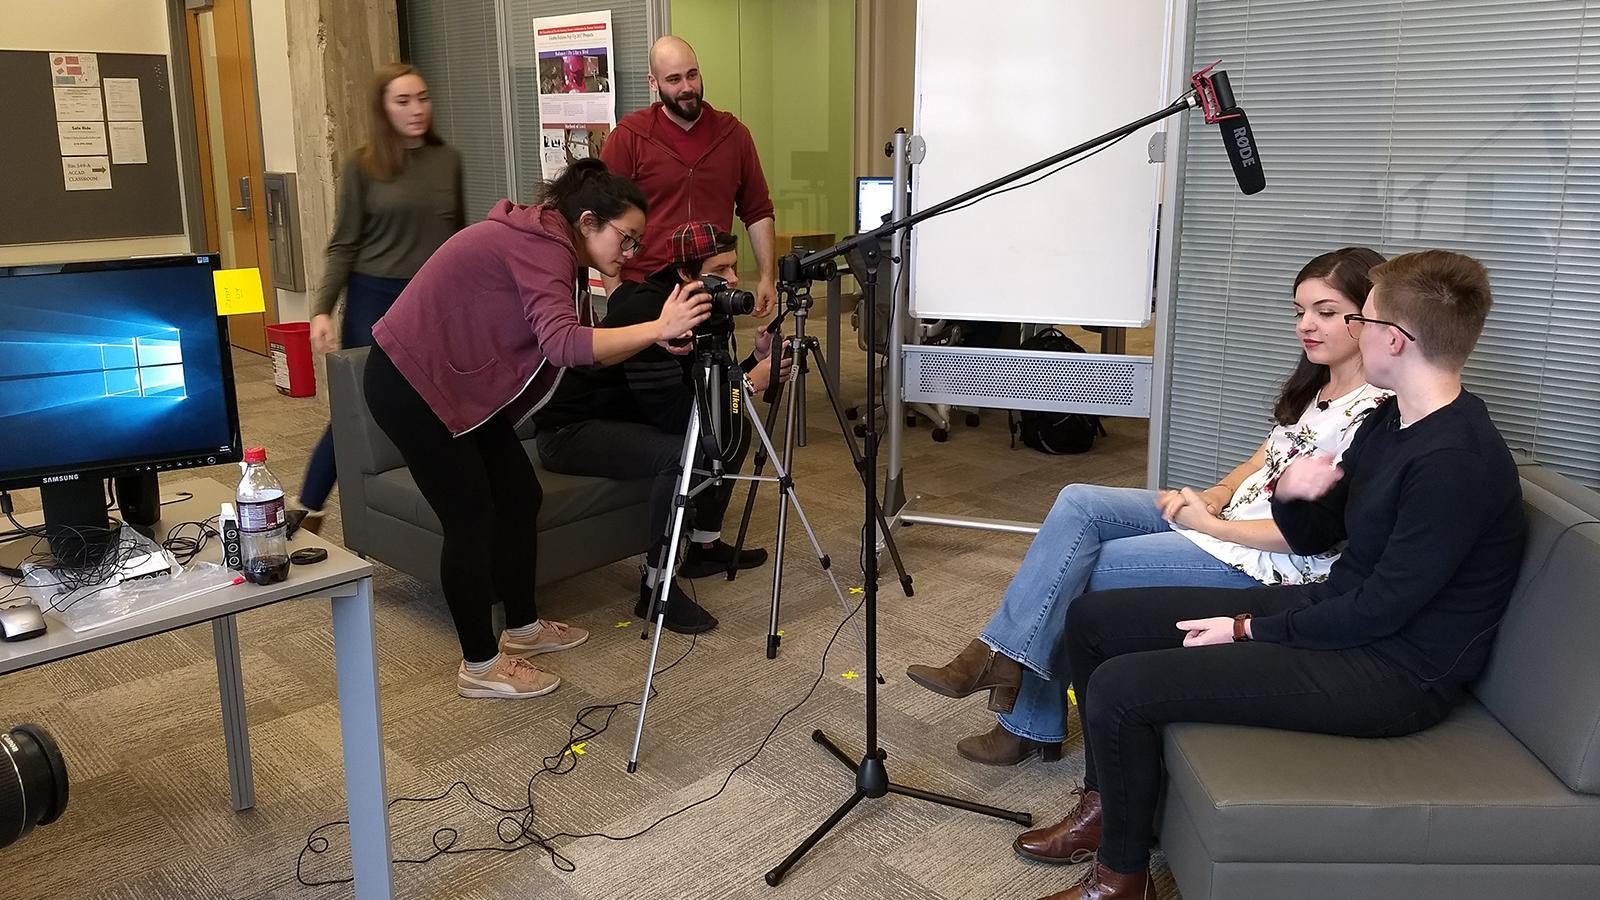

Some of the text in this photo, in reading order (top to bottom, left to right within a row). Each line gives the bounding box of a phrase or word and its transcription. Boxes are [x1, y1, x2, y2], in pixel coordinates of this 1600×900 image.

[1234, 127, 1255, 167] RØDE
[732, 388, 740, 413] Nikon
[42, 474, 79, 484] SAMSUNG
[1, 733, 19, 752] Canon
